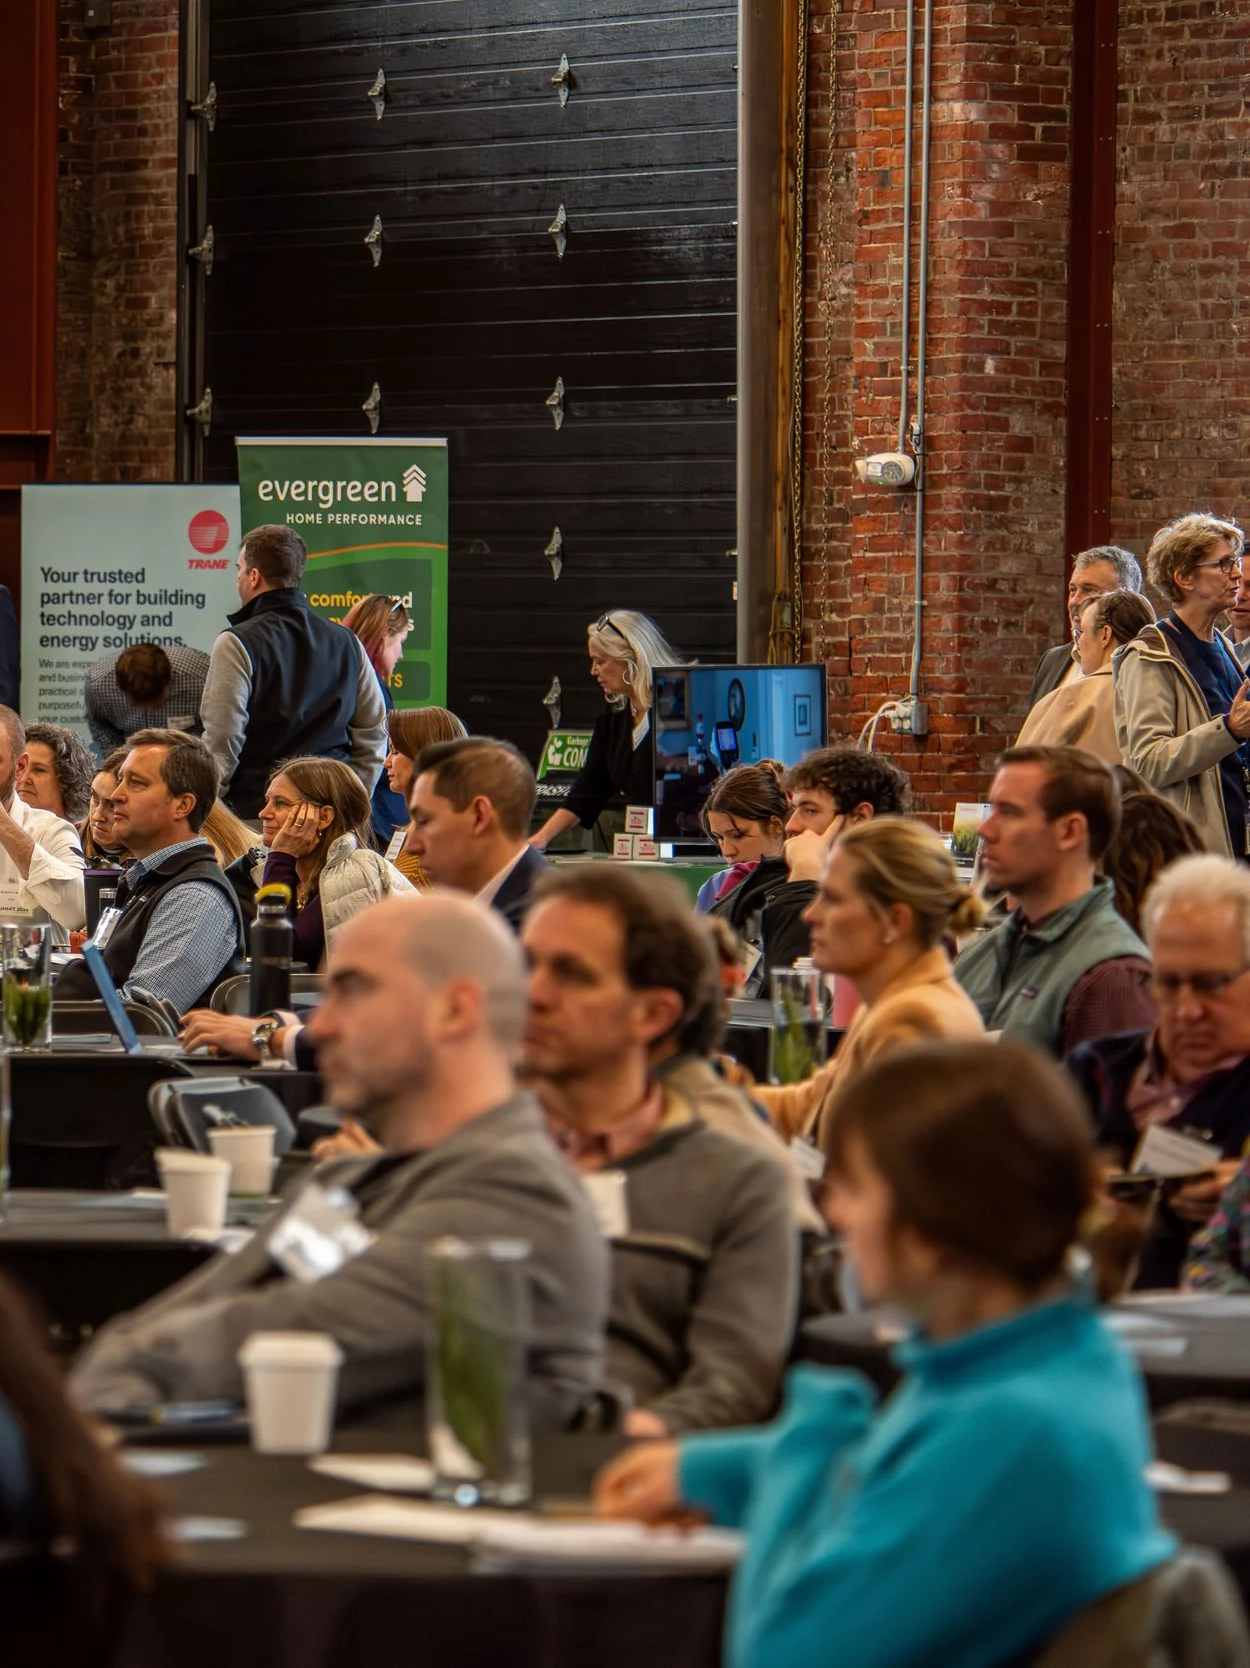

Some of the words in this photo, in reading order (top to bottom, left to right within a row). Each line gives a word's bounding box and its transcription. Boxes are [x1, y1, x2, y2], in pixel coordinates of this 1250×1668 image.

[258, 479, 397, 509] evergreen
[286, 512, 323, 525] HOME
[327, 513, 423, 526] PERFORMANCE
[187, 559, 230, 570] TRANE
[40, 566, 80, 584] Your
[83, 567, 146, 584] trusted
[40, 590, 104, 608] partner
[108, 589, 132, 605] for
[136, 589, 206, 609] building
[309, 591, 368, 608] comfo
[40, 611, 137, 630] technology
[140, 611, 173, 627] and
[40, 634, 99, 651] energy
[103, 632, 188, 648] solutions.
[38, 658, 54, 669] We
